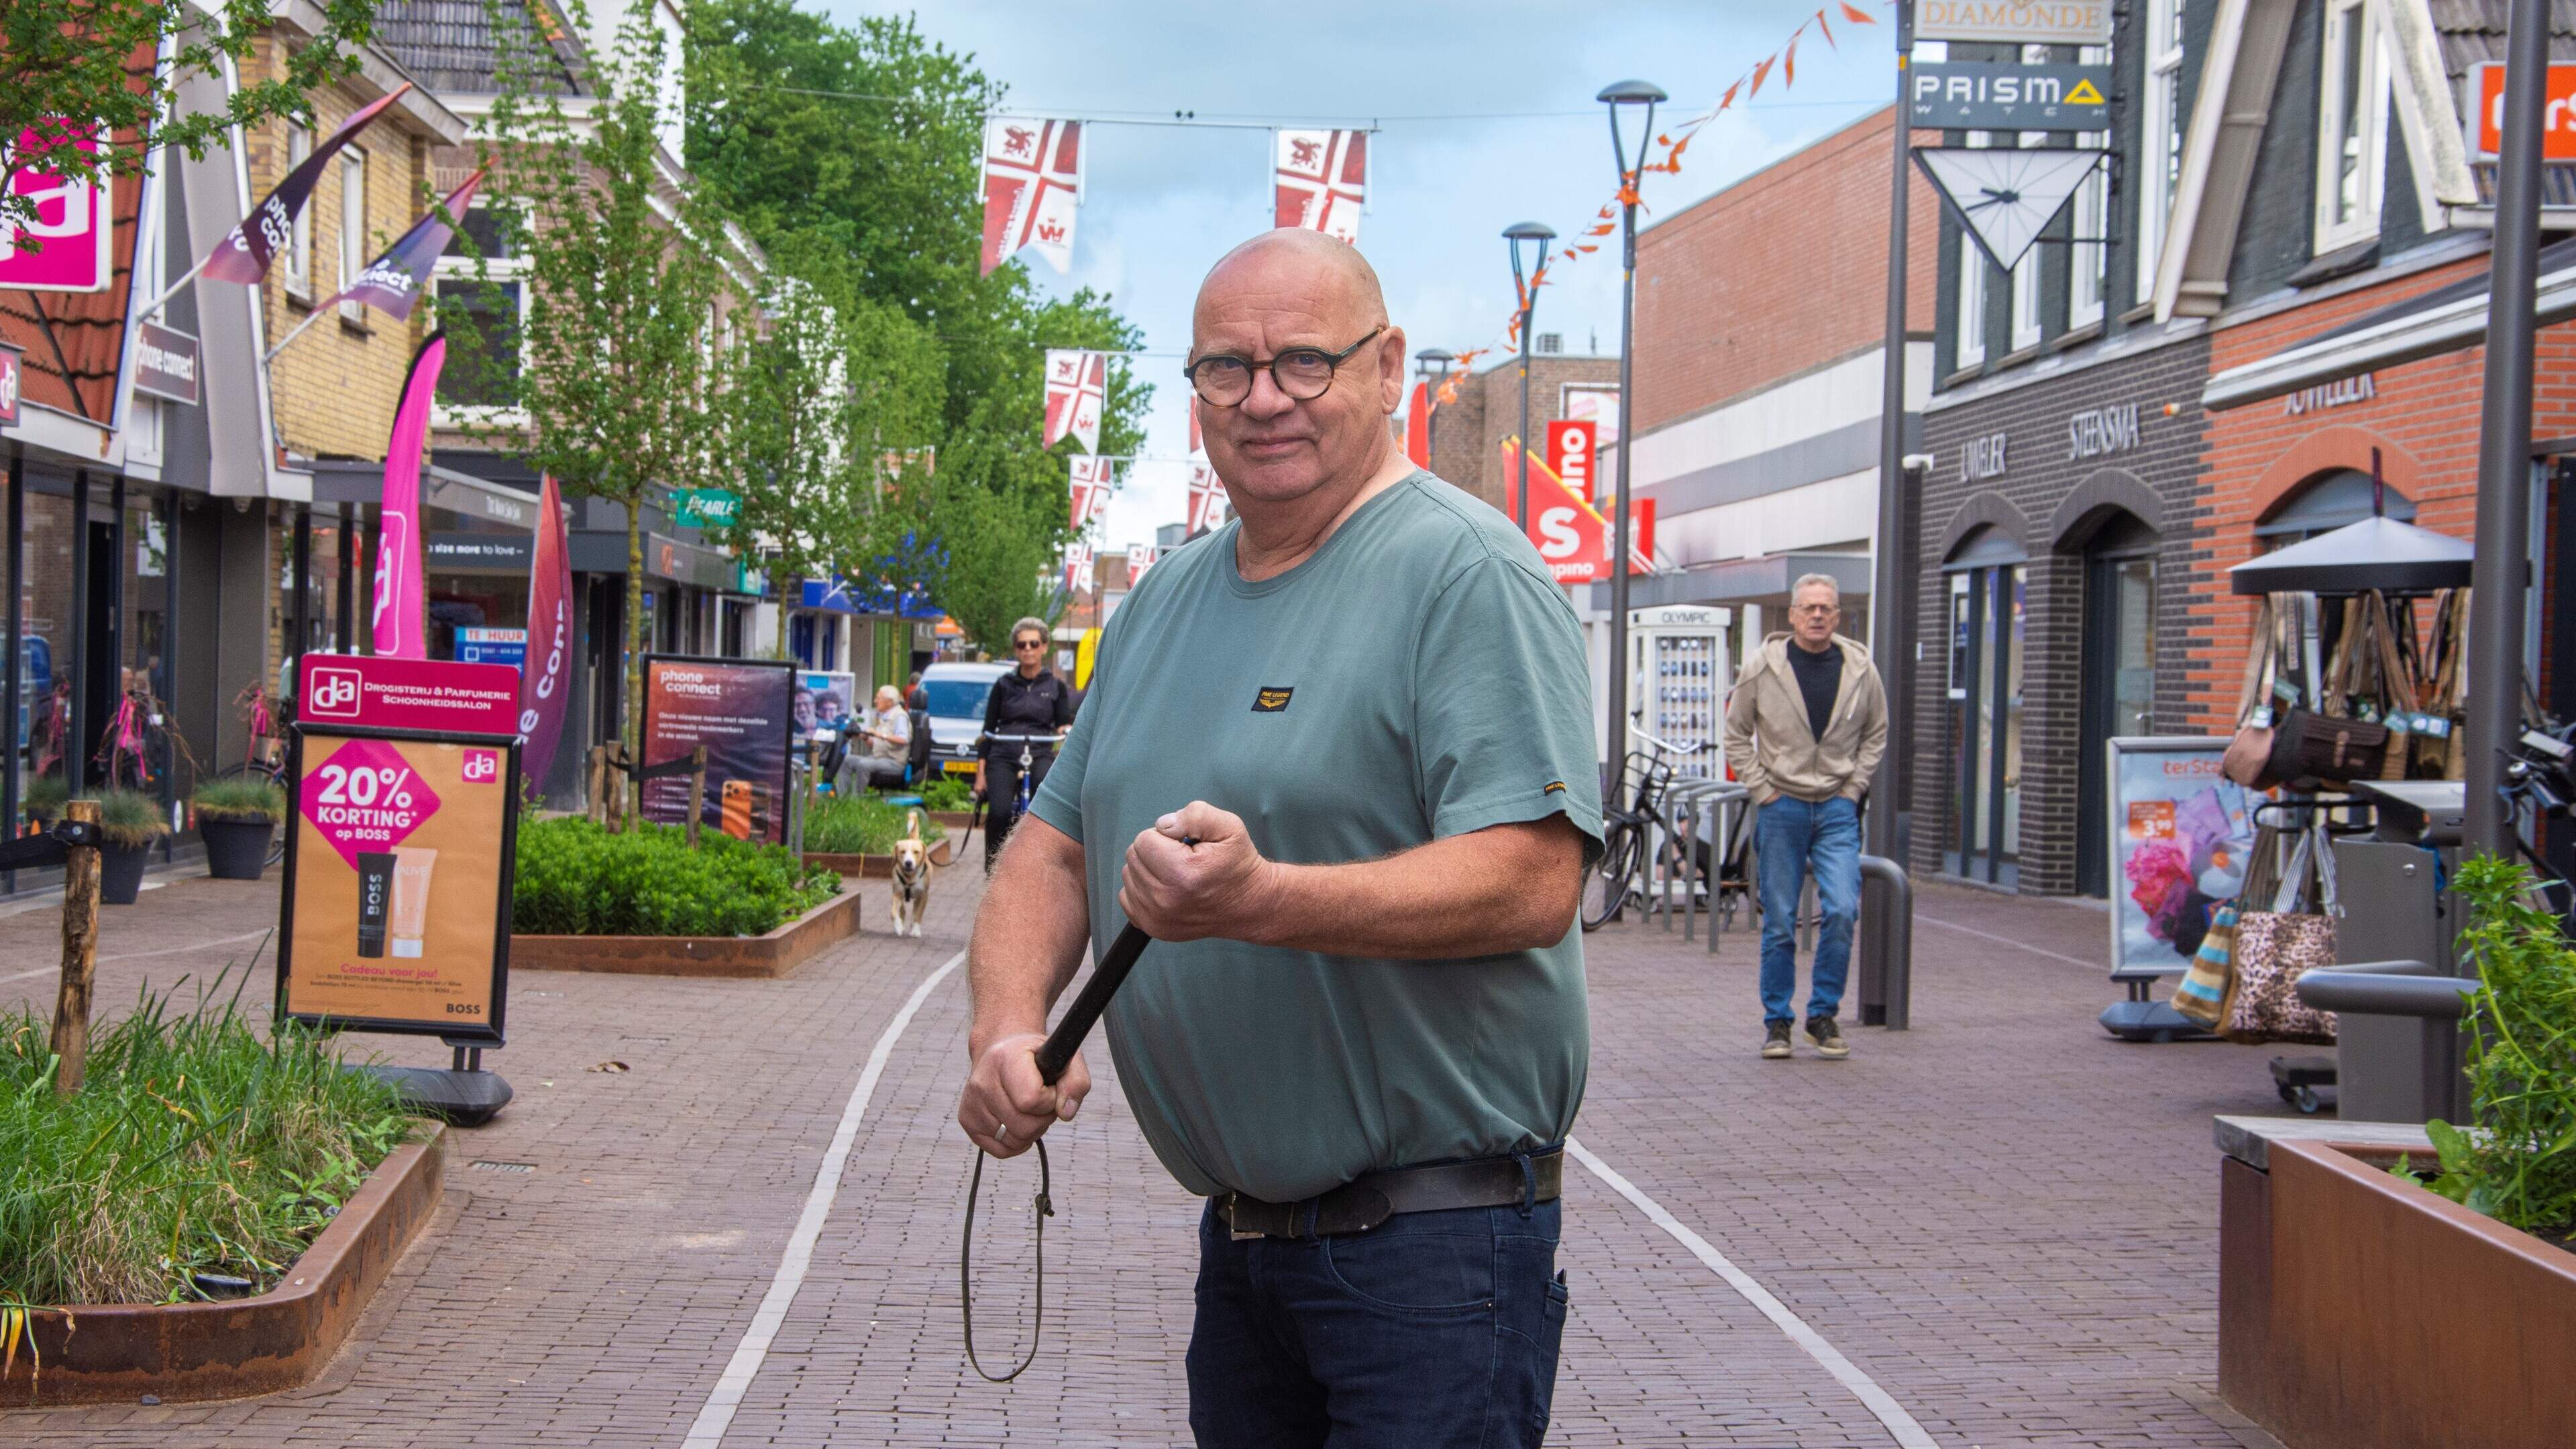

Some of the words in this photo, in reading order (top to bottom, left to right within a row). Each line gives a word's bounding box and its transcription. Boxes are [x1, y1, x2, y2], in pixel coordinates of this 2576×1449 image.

[1924, 2, 2102, 29] DIAMONDE
[1915, 76, 2105, 104] PRISMA
[1915, 105, 2106, 116] WATCH
[138, 337, 163, 375] phone
[163, 350, 194, 382] connect
[1960, 433, 2006, 482] JUWELIER
[2070, 402, 2140, 461] STEENSMA
[1539, 506, 1580, 558] S
[435, 543, 454, 554] size
[456, 544, 480, 554] more
[482, 544, 494, 555] to
[494, 544, 515, 555] love
[1662, 612, 1711, 624] OLYMPIC
[468, 629, 480, 640] TE
[488, 630, 523, 640] HUUR
[660, 670, 704, 684] phone
[313, 676, 355, 708] da
[433, 687, 442, 696] &
[665, 682, 721, 695] connect
[658, 712, 677, 720] Onze
[678, 713, 702, 722] nieuwe
[703, 715, 722, 723] naam
[723, 716, 737, 724] met
[658, 722, 698, 732] vertrouwde
[698, 724, 744, 735] medewerkers
[665, 731, 675, 739] de
[464, 753, 494, 779] da
[318, 765, 412, 808] 20%
[335, 828, 352, 841] op
[355, 828, 390, 841] BOSS
[367, 873, 382, 915] BOSS
[341, 963, 386, 975] Cadeau
[389, 967, 413, 977] voor
[415, 968, 437, 979] jou!
[446, 1003, 481, 1015] BOSS
